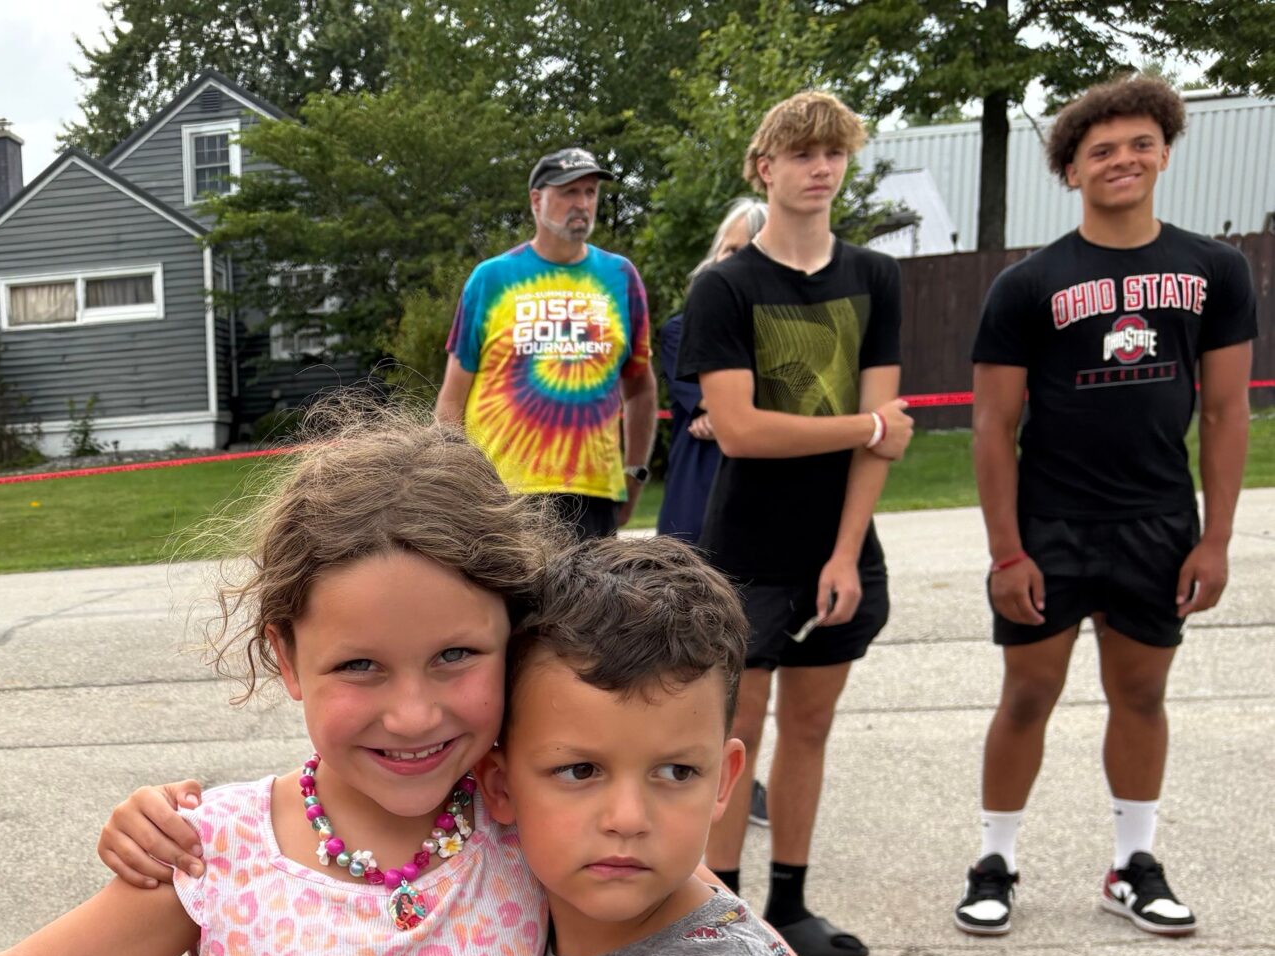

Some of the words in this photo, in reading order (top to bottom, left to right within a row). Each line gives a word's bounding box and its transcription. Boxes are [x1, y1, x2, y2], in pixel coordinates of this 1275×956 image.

[516, 299, 587, 321] DISC
[1051, 278, 1117, 330] OHIO
[1123, 273, 1207, 316] STATE
[513, 321, 587, 343] GOLF
[514, 341, 613, 355] TOURNAMENT
